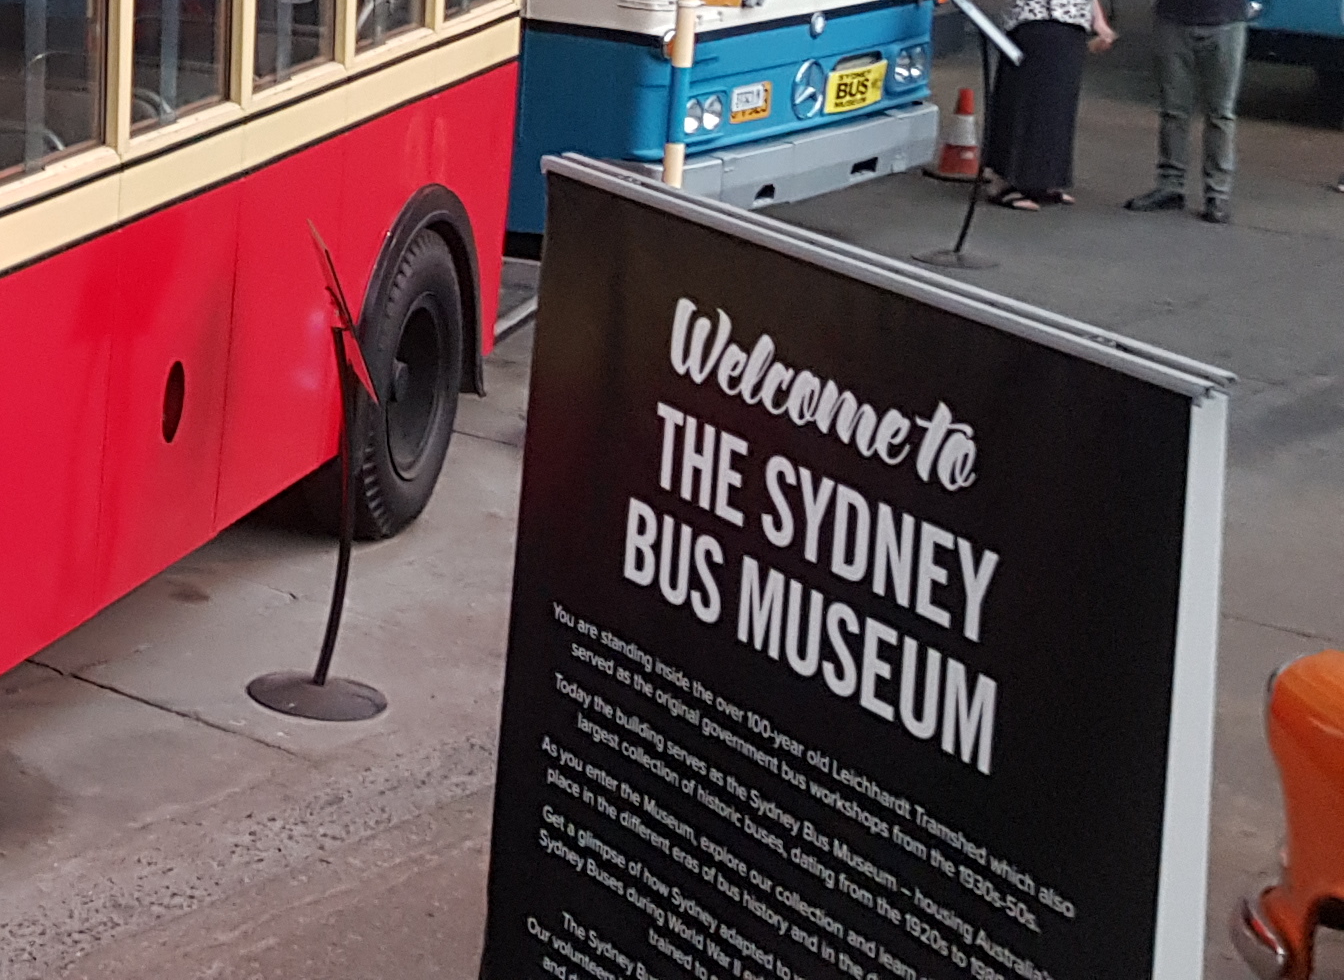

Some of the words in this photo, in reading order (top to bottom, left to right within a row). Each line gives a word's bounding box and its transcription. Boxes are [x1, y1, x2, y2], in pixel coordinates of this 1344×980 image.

[836, 79, 869, 100] BUS
[669, 296, 912, 467] Welcome
[914, 401, 978, 492] to
[623, 496, 725, 626] BUS
[737, 554, 999, 777] MUSEUM
[656, 401, 748, 528] THE
[761, 454, 1001, 644] SYDNEY
[541, 735, 558, 757] As
[559, 747, 583, 772] you
[585, 763, 619, 792] enter
[620, 782, 641, 806] the
[643, 795, 698, 847] Museum,
[700, 835, 748, 877] explore
[749, 869, 773, 893] our
[553, 601, 575, 627] You
[577, 619, 598, 639] are
[601, 630, 653, 673] standing
[655, 657, 691, 692] inside
[693, 680, 713, 705] the
[715, 696, 744, 723] over
[747, 710, 805, 759] 100-year
[806, 750, 830, 774] old
[832, 759, 912, 820] Leichhardt
[914, 804, 987, 866] Tramshed
[990, 855, 1035, 896] which
[1038, 886, 1076, 919] also
[554, 671, 592, 708] Today
[593, 695, 613, 719] the
[615, 706, 664, 753] building
[666, 740, 707, 776] serves
[709, 767, 724, 786] as
[726, 775, 747, 801] the
[749, 788, 800, 837] Sydney
[802, 820, 831, 852] Bus
[833, 838, 898, 893] Museum
[914, 886, 974, 945] housing
[571, 642, 614, 675] served
[616, 665, 631, 686] as
[633, 673, 654, 698] the
[655, 688, 701, 726] original
[701, 717, 779, 774] government
[781, 760, 807, 790] bus
[809, 780, 890, 838] workshops
[892, 824, 927, 860] from
[930, 848, 956, 877] the
[577, 711, 619, 750] largest
[621, 741, 680, 788] collection
[681, 777, 696, 797] of
[697, 783, 743, 828] historic
[744, 815, 788, 859] buses,
[790, 846, 835, 890] dating
[838, 872, 874, 908] from
[876, 896, 902, 925] the
[904, 912, 949, 957] 1920s
[951, 944, 968, 968] to
